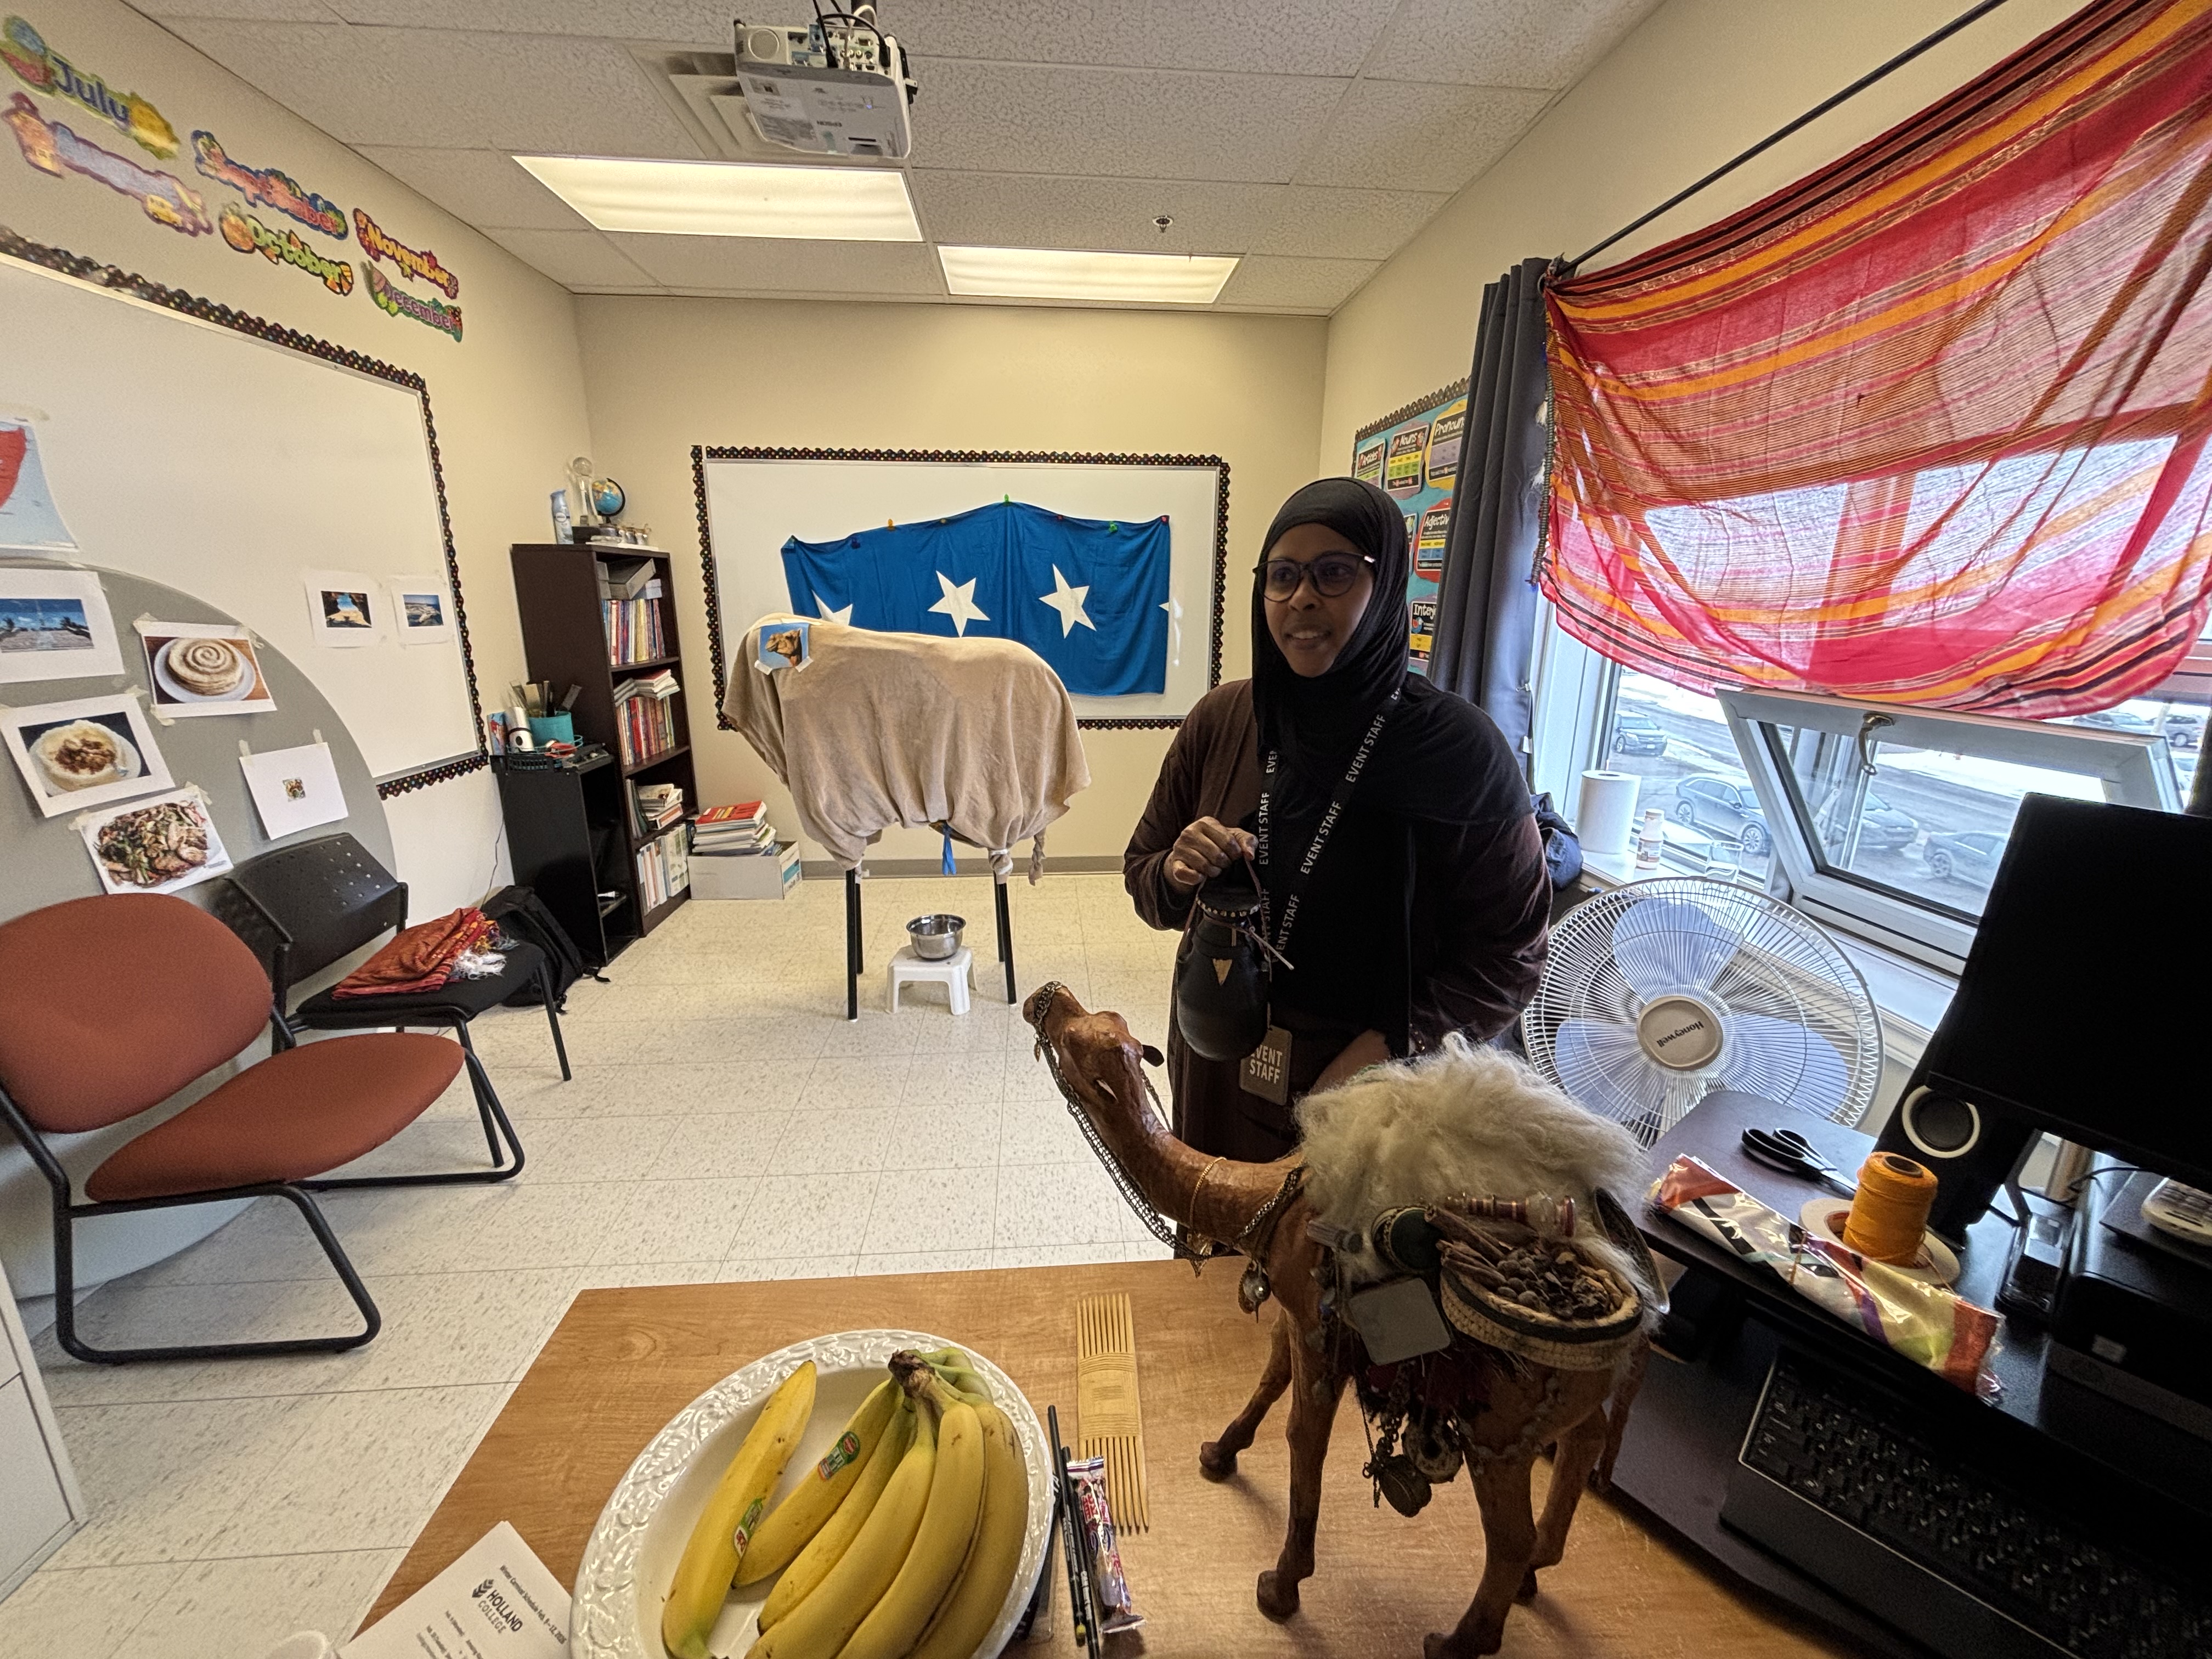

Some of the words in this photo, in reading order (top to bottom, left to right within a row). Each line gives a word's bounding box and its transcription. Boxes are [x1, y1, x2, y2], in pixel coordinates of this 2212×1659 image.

[245, 218, 342, 283] October
[367, 222, 449, 287] November
[1400, 432, 1418, 447] Nouns
[1345, 745, 1369, 783] EVENT
[1364, 714, 1386, 746] STAFF
[1259, 792, 1270, 824] STAFF
[1259, 826, 1269, 865] EVENT
[1300, 835, 1324, 874] EVENT
[1319, 801, 1342, 836] STAFF
[1282, 894, 1300, 928] STAFF
[1657, 1021, 1705, 1047] Honeywell
[1249, 1059, 1280, 1084] STAFF
[1251, 1045, 1283, 1067] VENT
[478, 1600, 506, 1634] COLLEGE
[487, 1589, 523, 1632] HOLLAND
